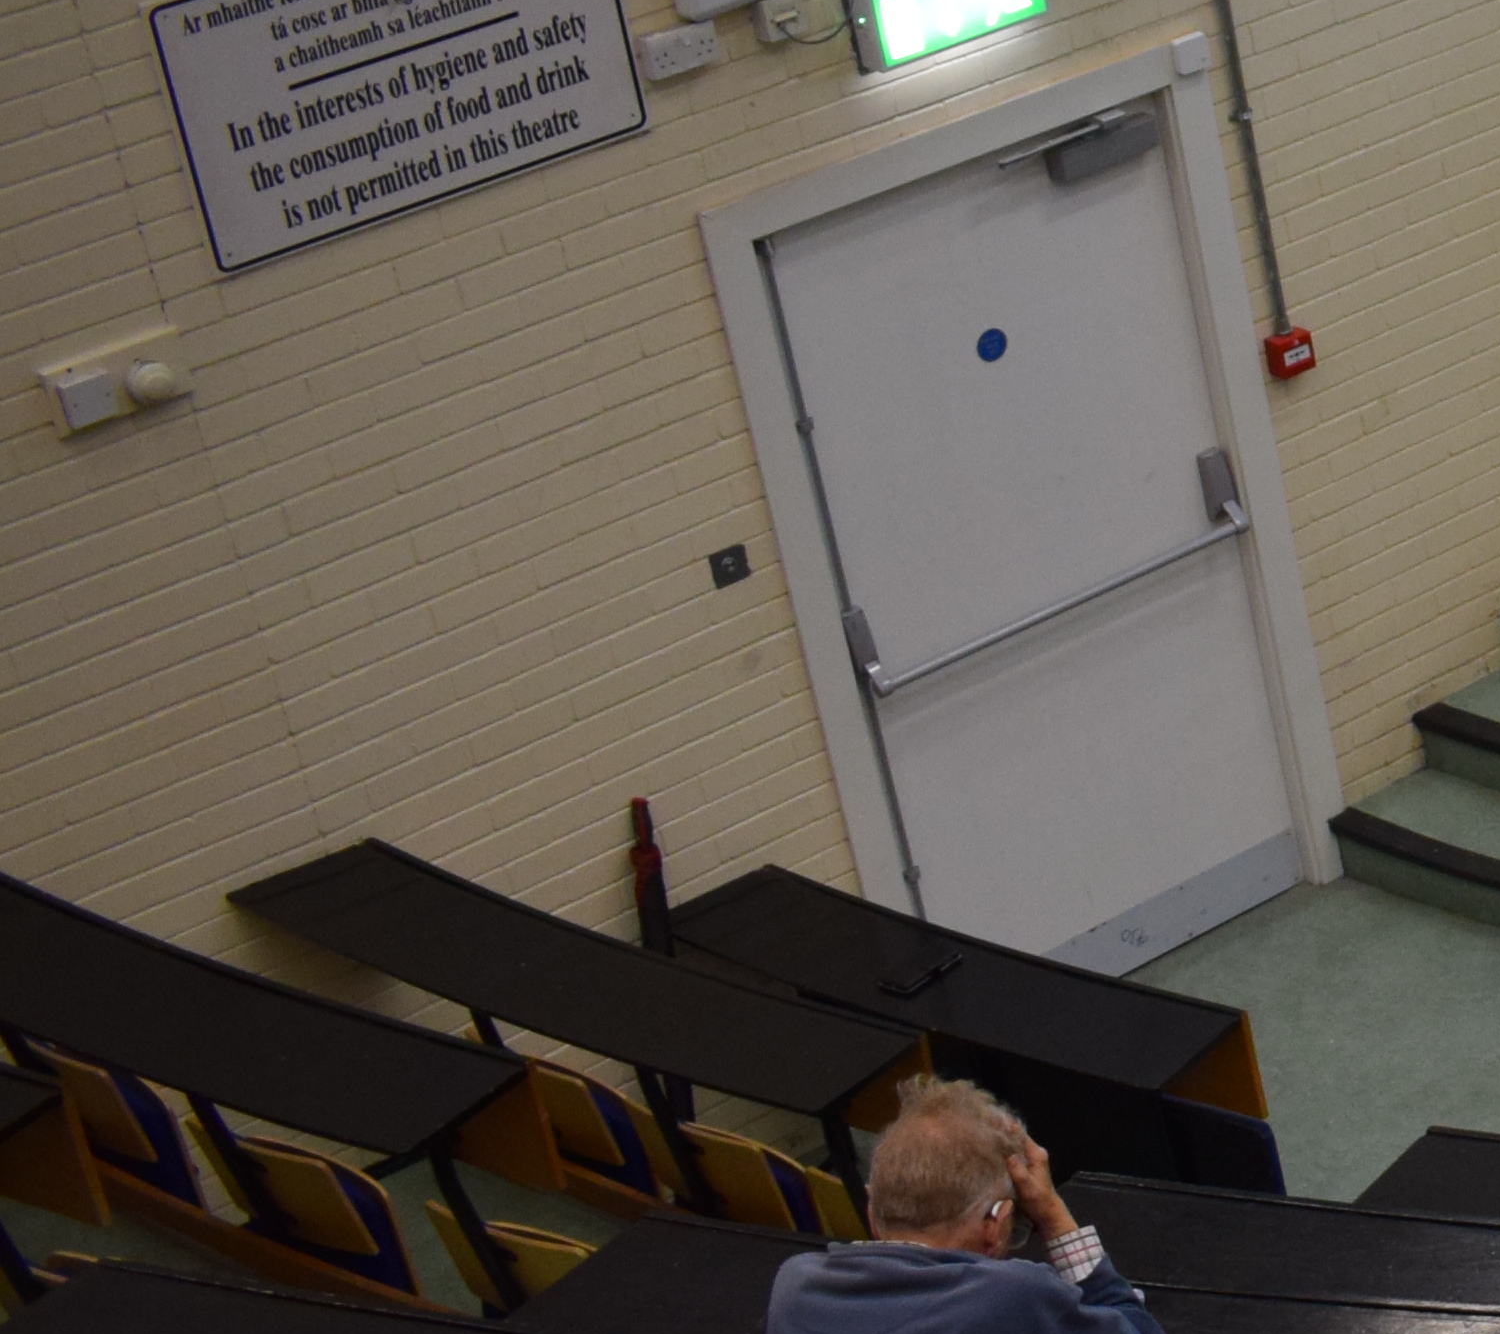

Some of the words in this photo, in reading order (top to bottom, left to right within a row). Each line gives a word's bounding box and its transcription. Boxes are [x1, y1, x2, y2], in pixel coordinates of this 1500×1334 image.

[182, 13, 202, 37] Ar
[269, 14, 289, 41] tá
[290, 9, 328, 35] cosc
[329, 1, 348, 23] ar
[273, 55, 286, 74] a
[287, 19, 385, 68] chaitheamh
[385, 17, 406, 36] sa
[225, 121, 256, 153] In
[255, 109, 293, 143] the
[292, 79, 385, 130] interests
[386, 64, 410, 99] of
[408, 47, 488, 95] hygiene
[490, 26, 530, 65] and
[531, 12, 586, 51] safety
[248, 160, 286, 193] the
[287, 116, 421, 180] consumption
[422, 99, 445, 134] of
[445, 84, 492, 126] food
[493, 71, 533, 110] and
[534, 54, 590, 96] drink
[280, 198, 304, 229] is
[304, 184, 343, 221] not
[343, 148, 443, 216] permitted
[442, 143, 468, 173] in
[468, 127, 509, 164] this
[510, 108, 580, 150] theatre
